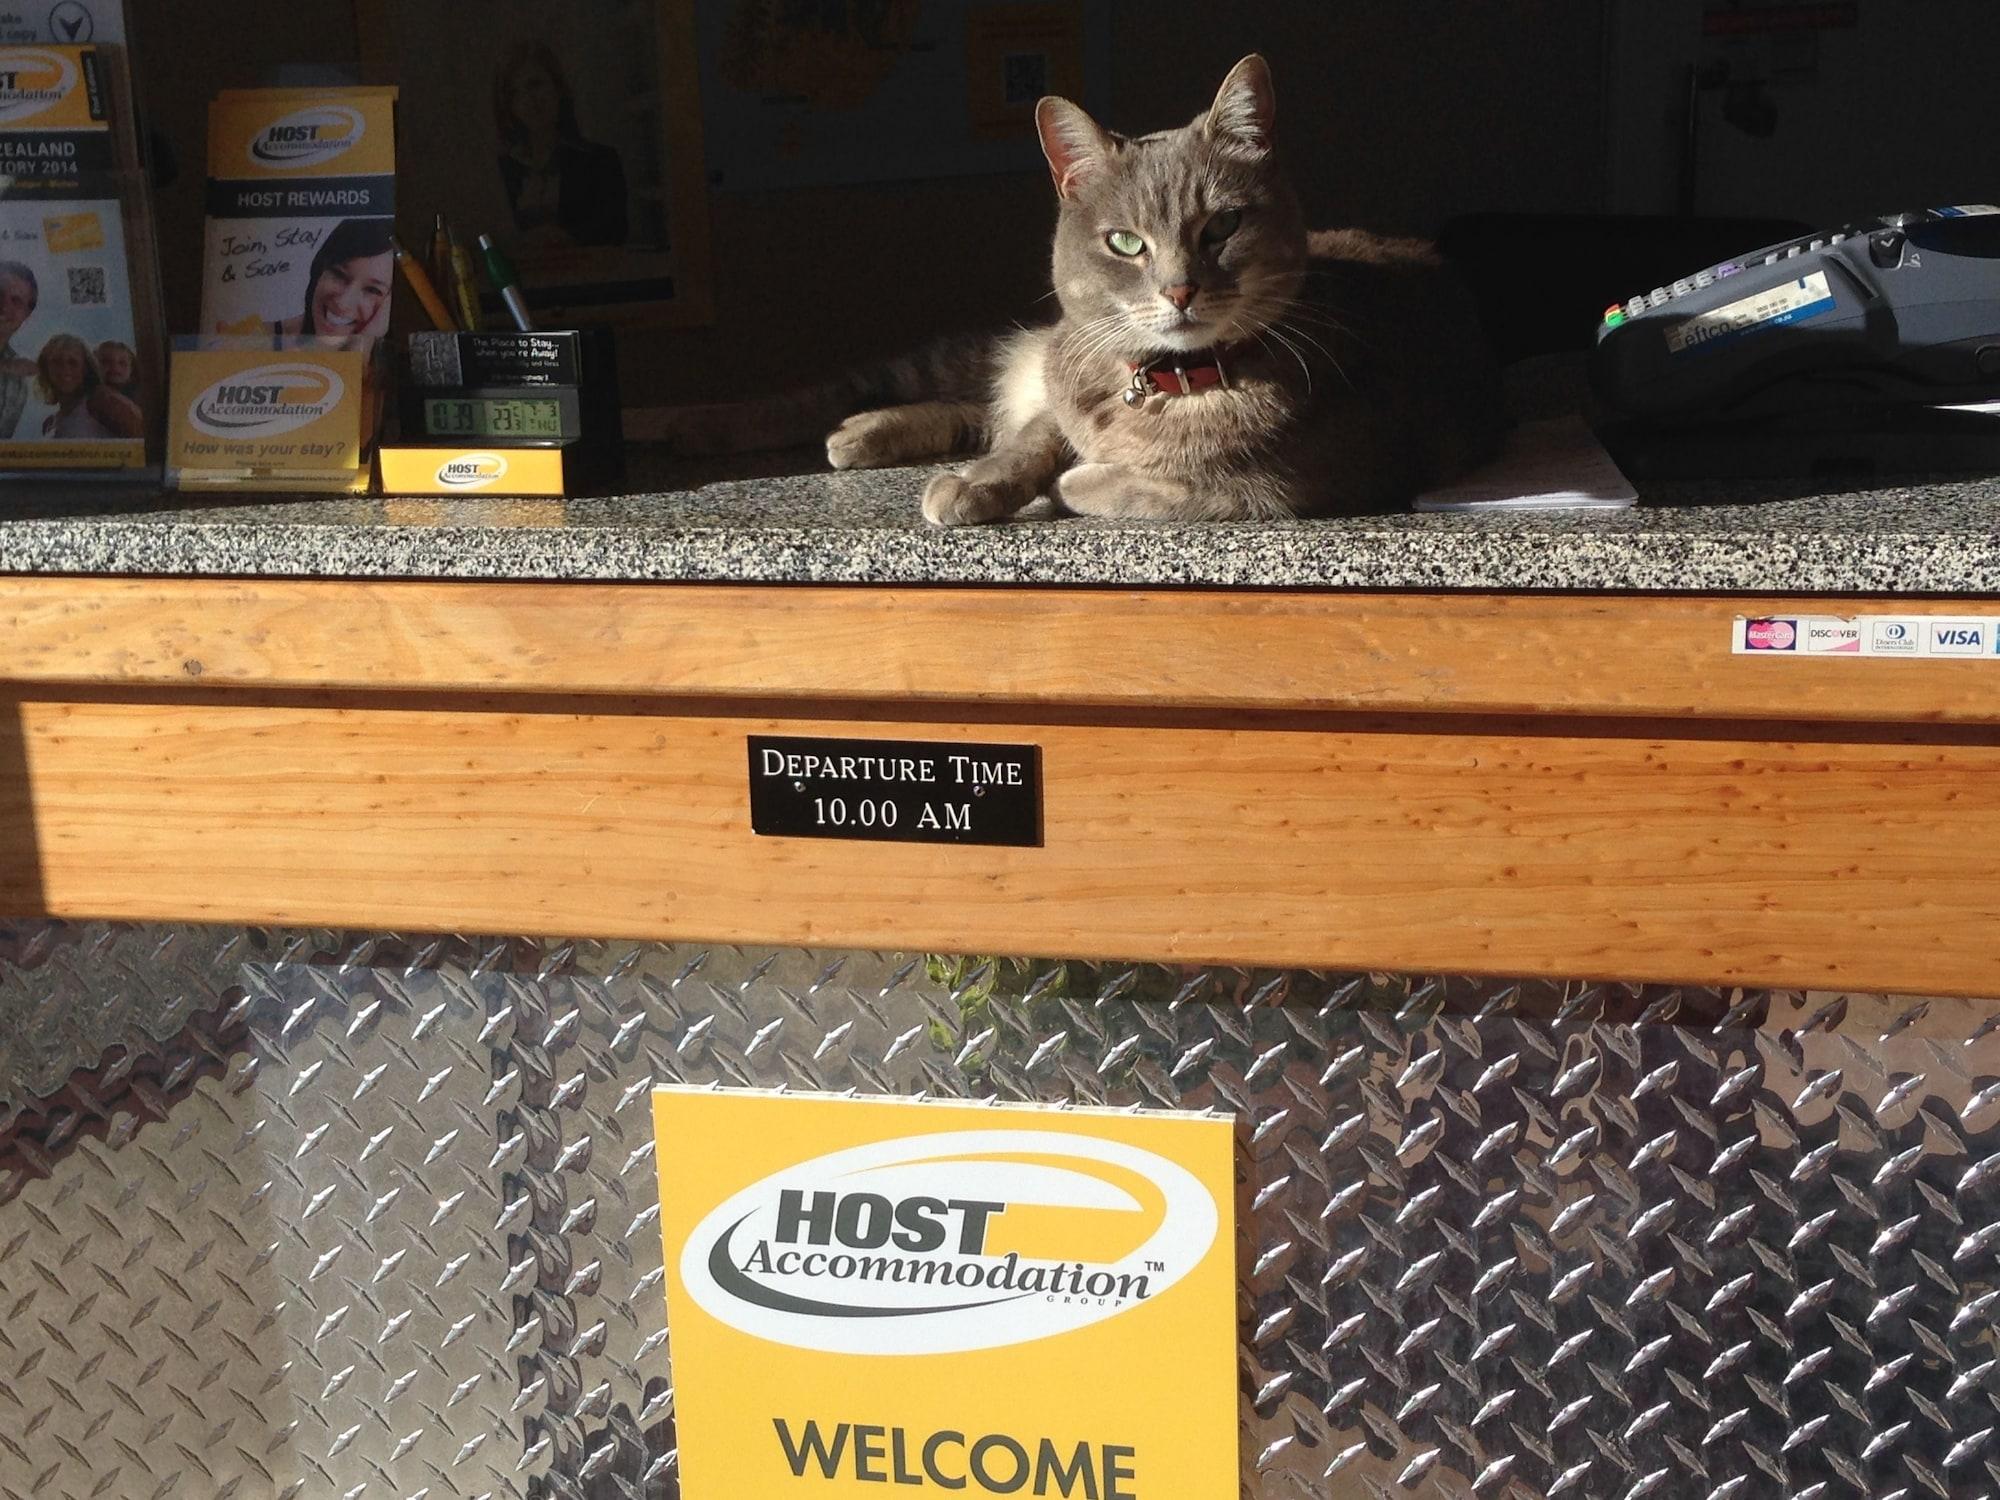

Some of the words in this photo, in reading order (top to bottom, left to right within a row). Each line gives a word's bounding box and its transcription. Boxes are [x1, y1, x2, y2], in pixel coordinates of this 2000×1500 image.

[269, 126, 319, 142] HOST
[41, 160, 78, 174] 2014
[238, 192, 284, 208] HOST
[288, 189, 370, 206] REWARDS
[275, 228, 322, 250] Stay
[222, 266, 236, 282] &
[245, 260, 291, 280] Save
[518, 338, 528, 347] to
[216, 385, 283, 405] HOST
[207, 402, 323, 416] Accommodation
[184, 441, 219, 455] How
[224, 443, 254, 455] was
[259, 443, 295, 458] your
[300, 441, 346, 458] stay?
[448, 464, 480, 474] HOST
[1810, 629, 1857, 639] DISCOVER
[1937, 630, 1981, 646] VISA
[761, 748, 936, 782] DEPARTURE
[948, 755, 1024, 786] TIME
[814, 797, 898, 827] 10.00
[916, 802, 972, 830] AM
[774, 1189, 1005, 1256] HOST
[741, 1239, 1151, 1300] Accommodation
[1047, 1295, 1122, 1307] GROUP
[771, 1417, 1137, 1500] WELCOME
